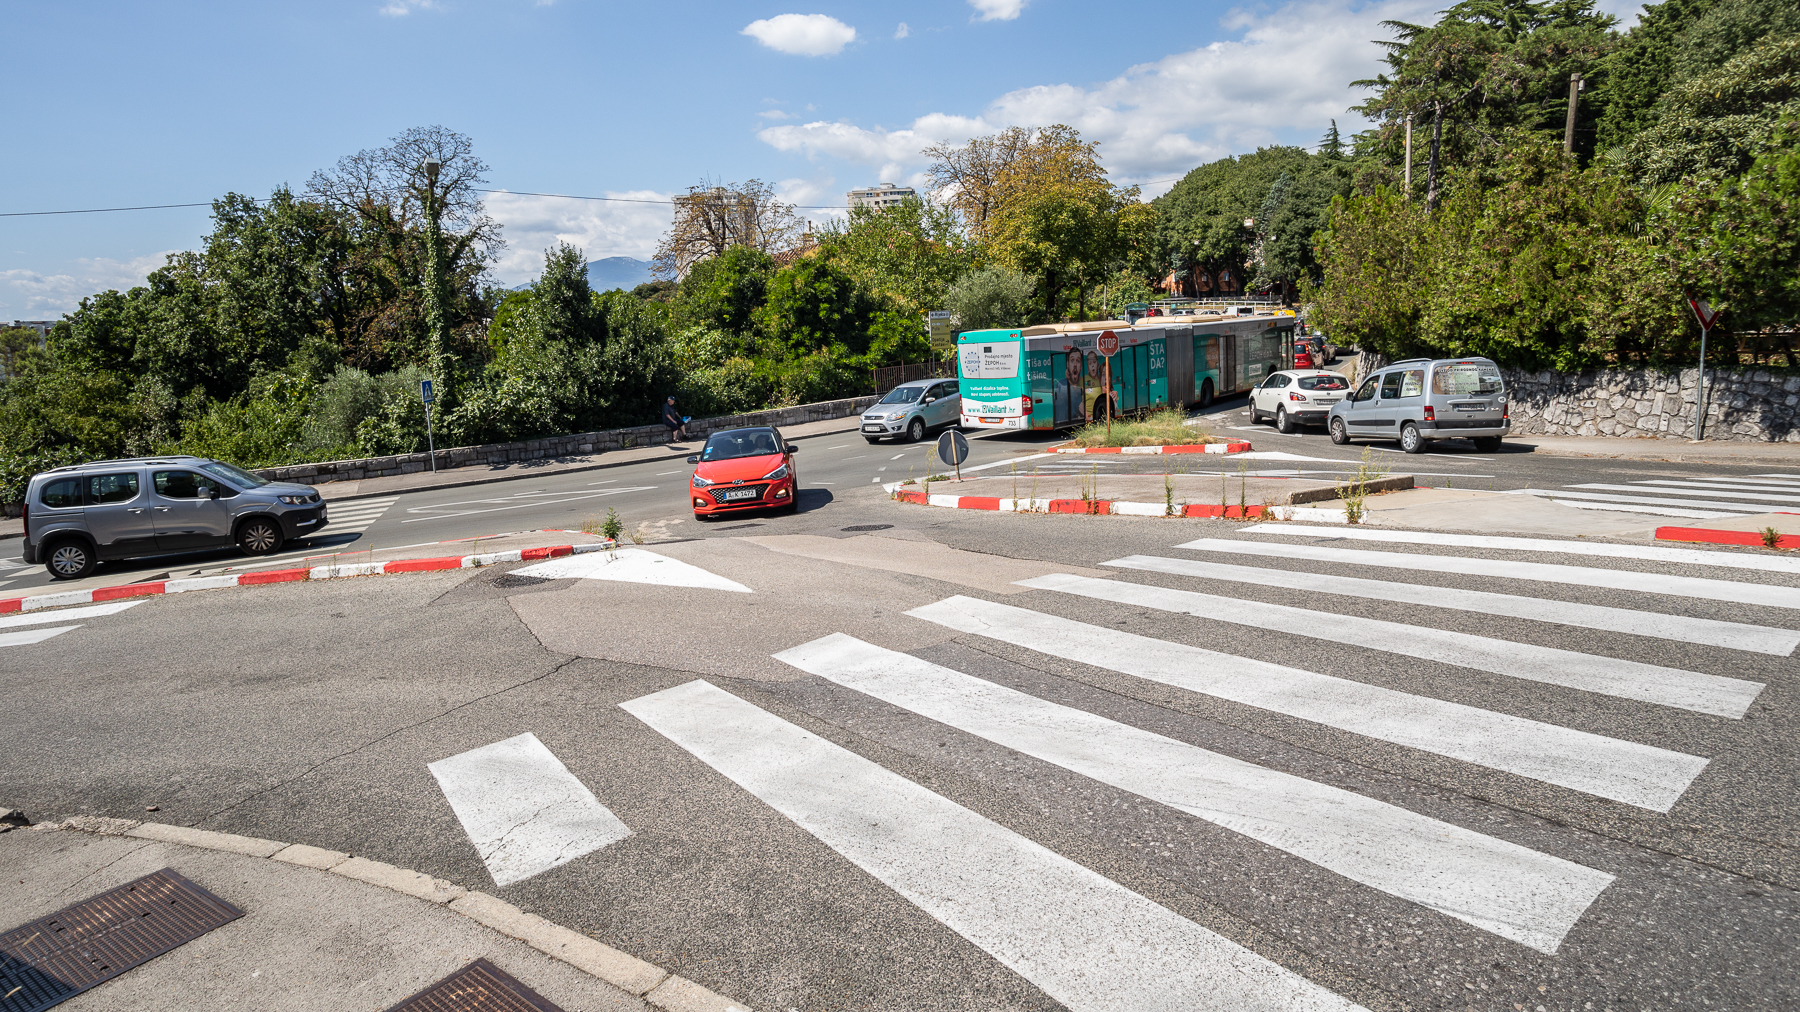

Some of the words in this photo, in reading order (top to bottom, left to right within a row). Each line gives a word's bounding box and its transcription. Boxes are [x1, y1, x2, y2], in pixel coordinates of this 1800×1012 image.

[1100, 338, 1116, 349] STOP
[1150, 341, 1164, 356] ŠTA
[1026, 358, 1041, 368] Tiša
[1043, 357, 1051, 366] od
[1150, 357, 1164, 370] DA?
[1026, 370, 1046, 380] tišine
